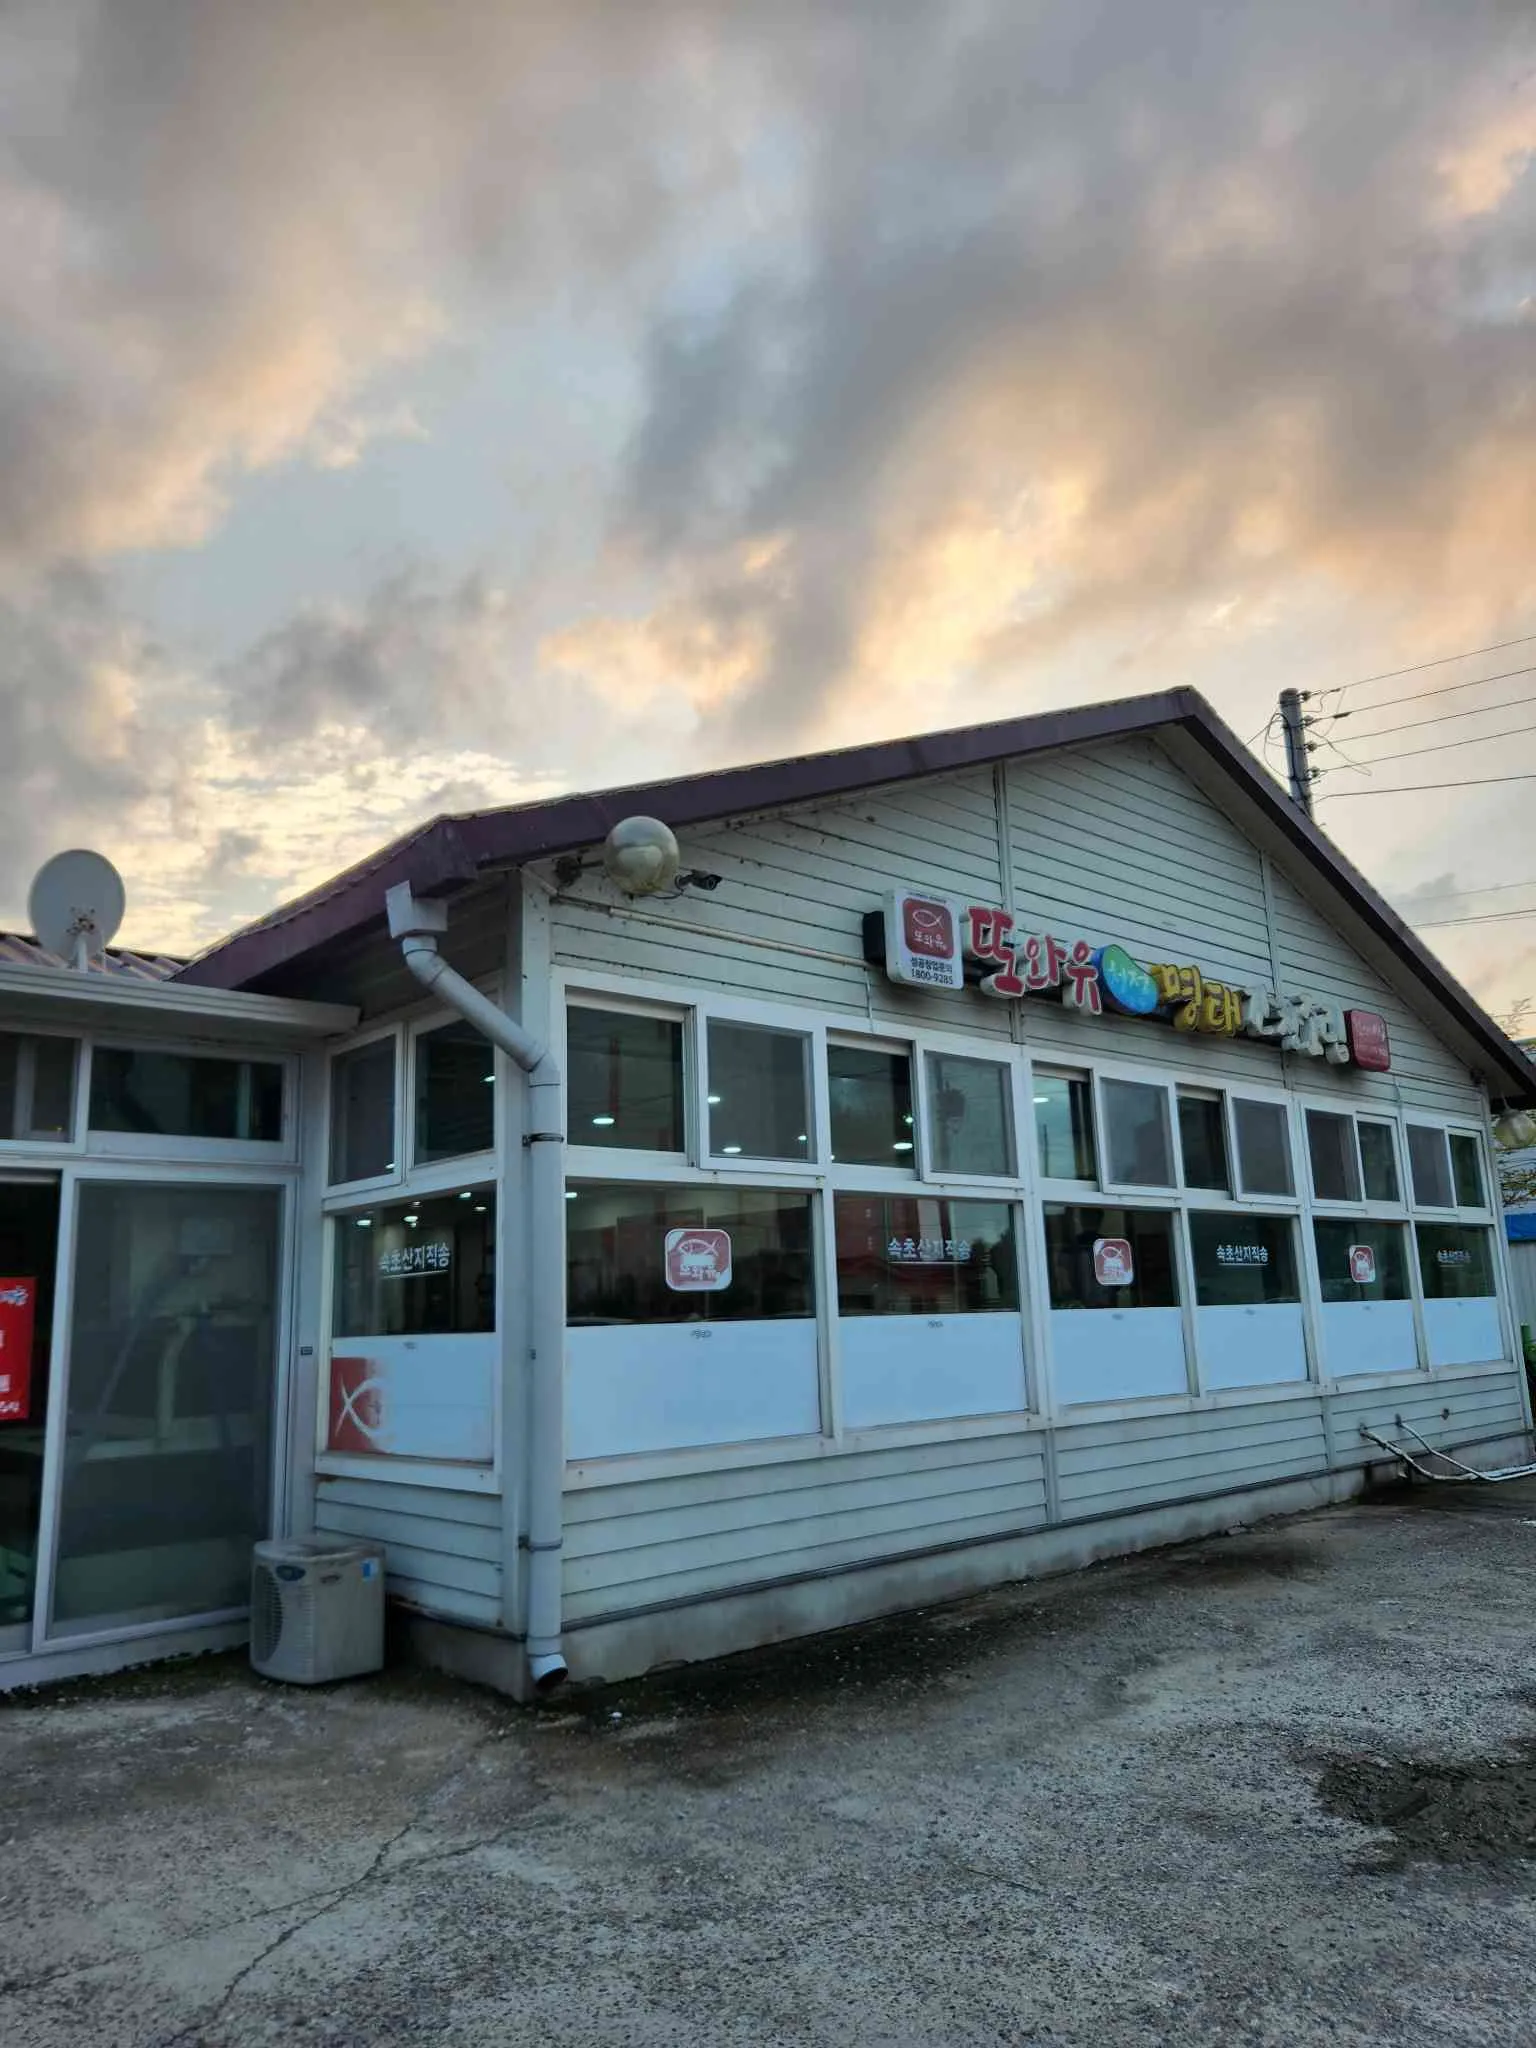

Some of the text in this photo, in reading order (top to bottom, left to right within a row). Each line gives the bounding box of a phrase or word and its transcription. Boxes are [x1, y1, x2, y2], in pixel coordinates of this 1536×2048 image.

[967, 906, 1101, 1015] 또와유
[376, 1241, 451, 1273] 속초산지직송
[887, 1237, 971, 1260] 속초산지직송
[1215, 1244, 1269, 1264] 속초산지직송
